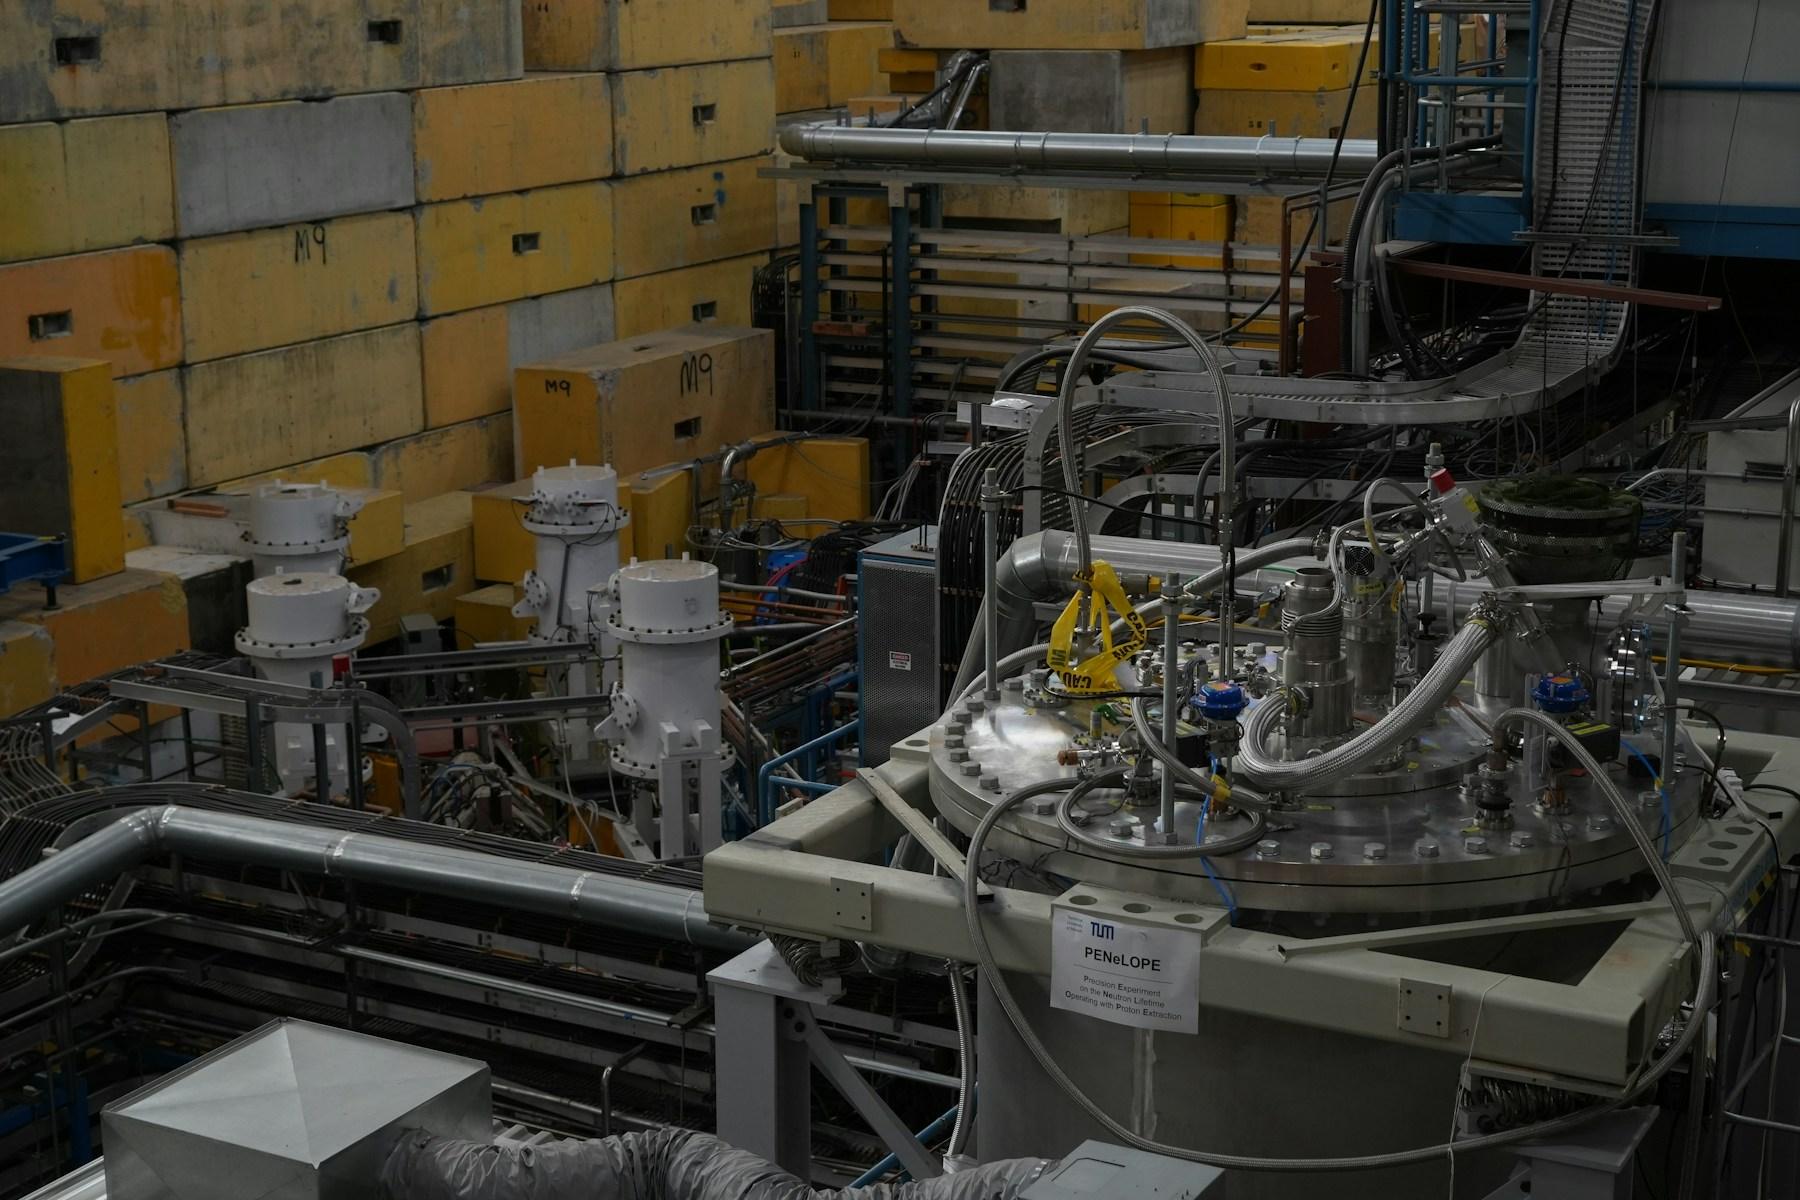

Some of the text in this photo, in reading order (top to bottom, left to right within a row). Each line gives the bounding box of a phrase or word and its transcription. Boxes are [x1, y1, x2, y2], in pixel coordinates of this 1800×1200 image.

[295, 225, 326, 265] M9
[680, 353, 713, 398] M9
[545, 379, 571, 398] M9
[1090, 921, 1114, 941] TUM
[1085, 947, 1161, 972] PENeLOPE
[1080, 985, 1166, 1009] on the Neutron Lifetime
[1083, 975, 1161, 998] Precision Experiment
[1065, 990, 1182, 1021] Operating with Proton Extraction
